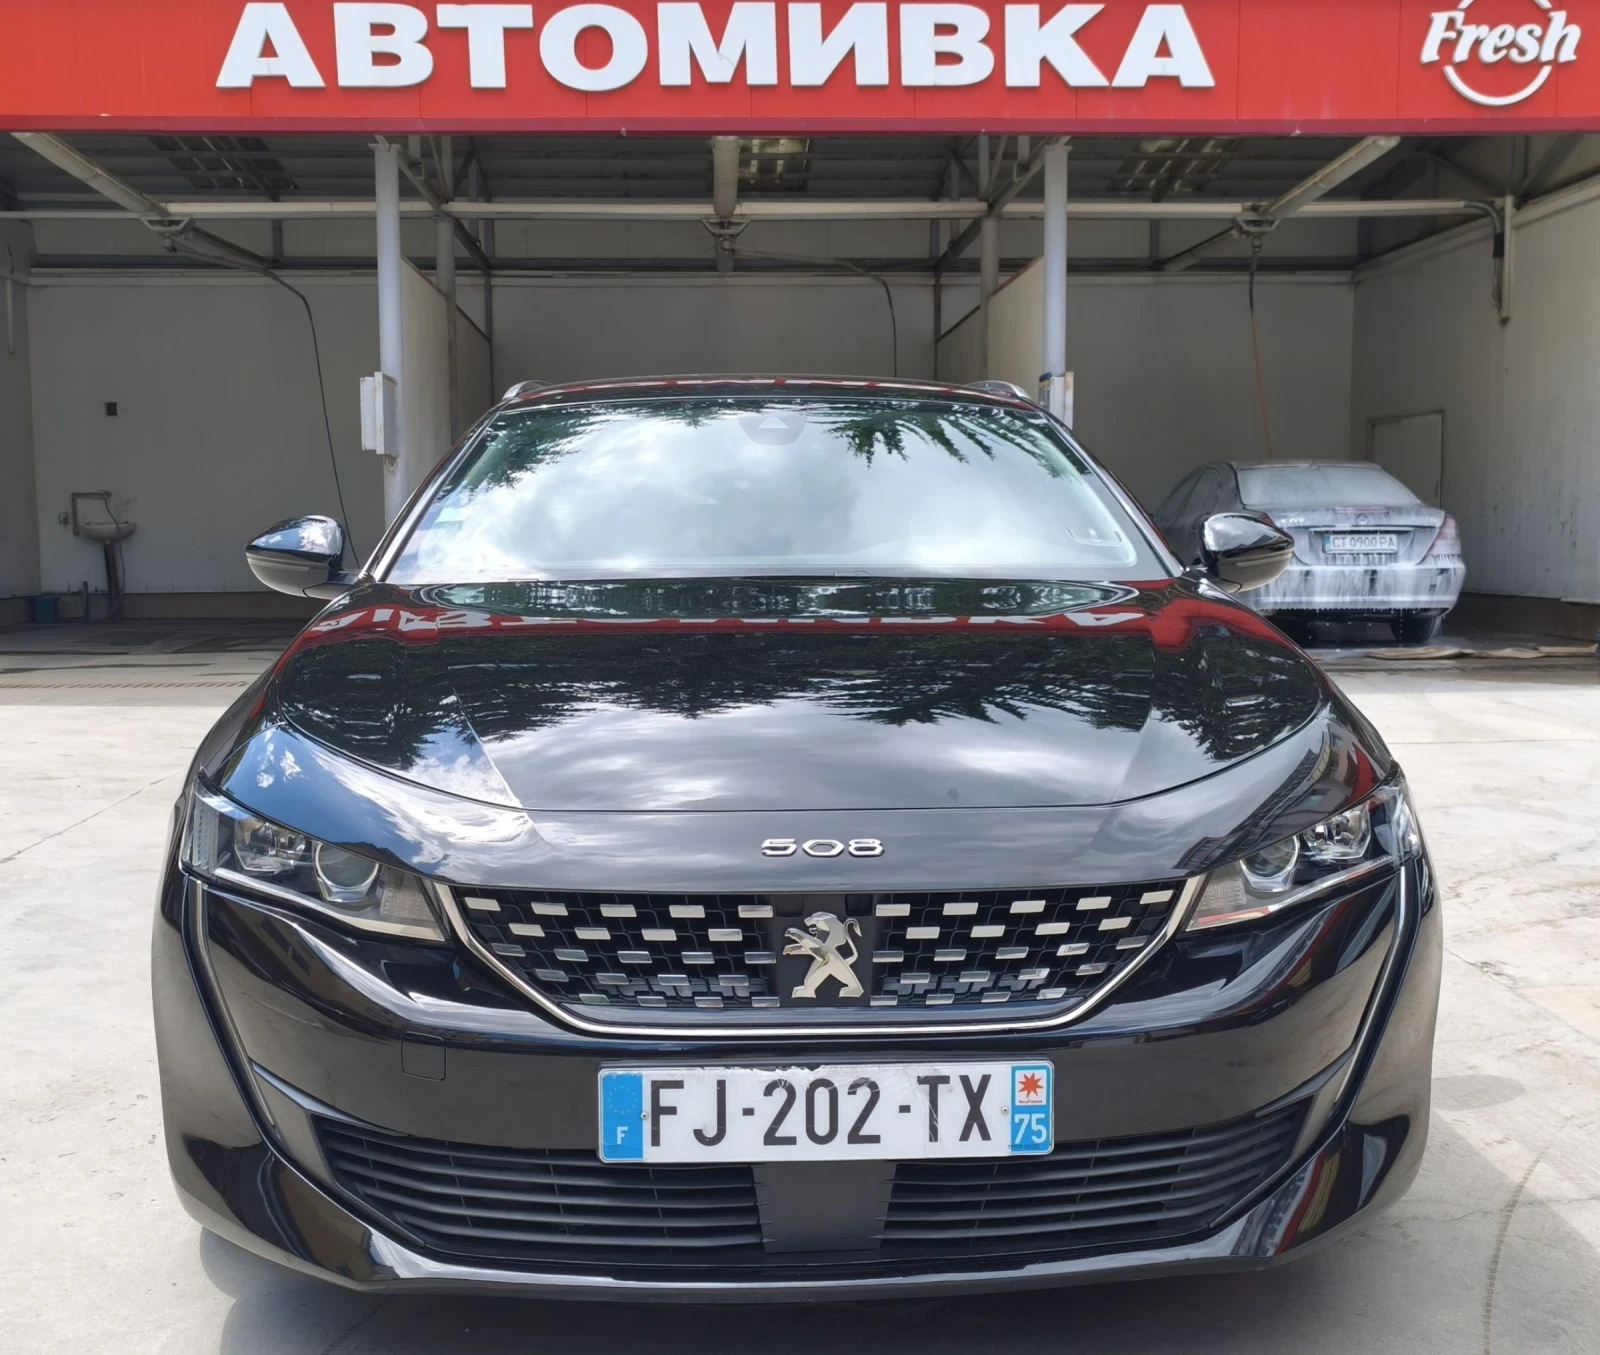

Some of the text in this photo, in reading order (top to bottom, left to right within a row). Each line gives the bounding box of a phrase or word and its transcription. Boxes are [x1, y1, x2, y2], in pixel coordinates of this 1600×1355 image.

[215, 1, 1216, 92] АВТОМИВКА
[1420, 10, 1582, 64] Fresh
[1332, 536, 1347, 548] CT
[1350, 536, 1377, 548] 0900
[761, 838, 884, 857] 508
[650, 1074, 992, 1147] FJ-202-TX
[616, 1126, 628, 1145] F
[1014, 1113, 1047, 1144] 75
